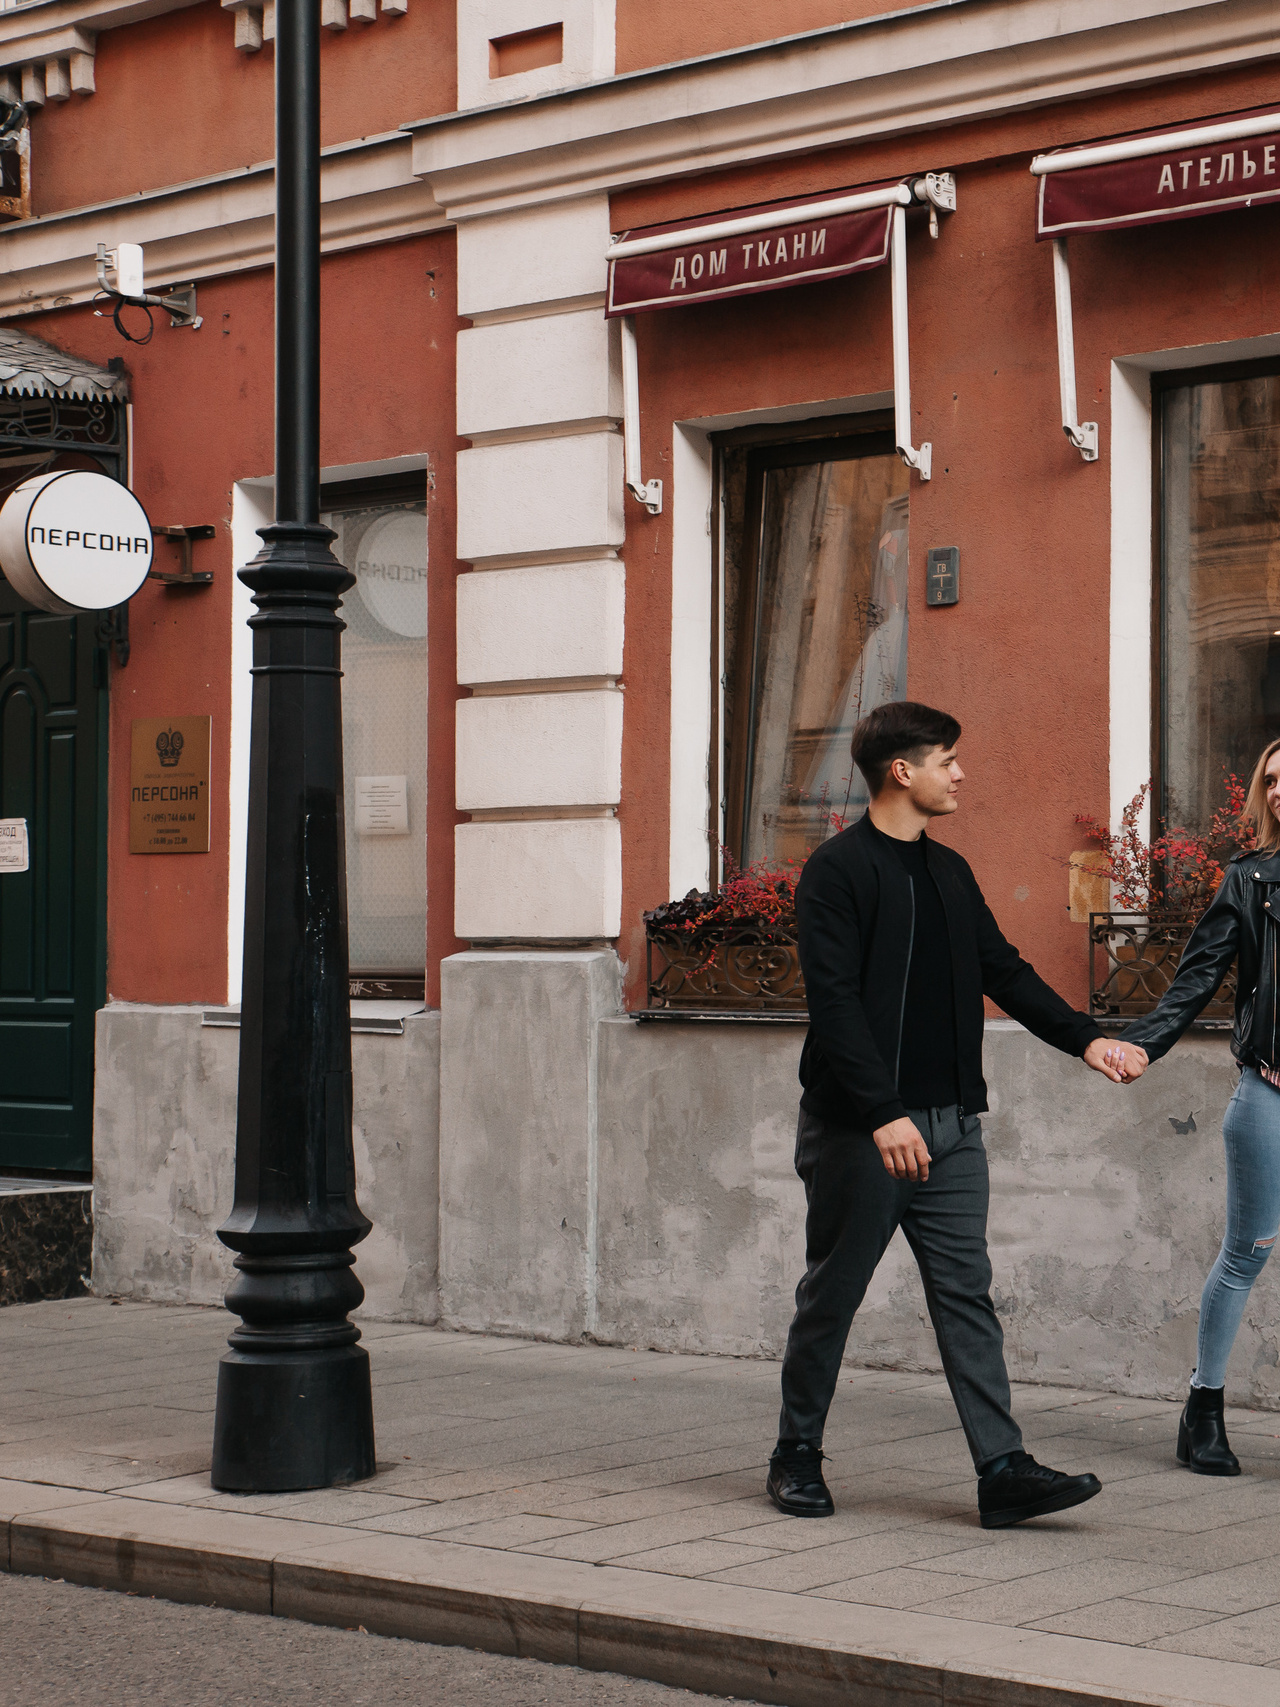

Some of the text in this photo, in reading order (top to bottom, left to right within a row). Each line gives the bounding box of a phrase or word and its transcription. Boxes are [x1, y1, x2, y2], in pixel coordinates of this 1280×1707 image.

[1157, 144, 1276, 194] АТЕЛЬЕ
[669, 228, 827, 290] ДОМ ТКАНИ
[31, 526, 149, 554] ПЕРСОНА
[936, 563, 947, 573] ГВ
[937, 591, 942, 601] 9
[132, 785, 198, 802] ПЕРСОНА
